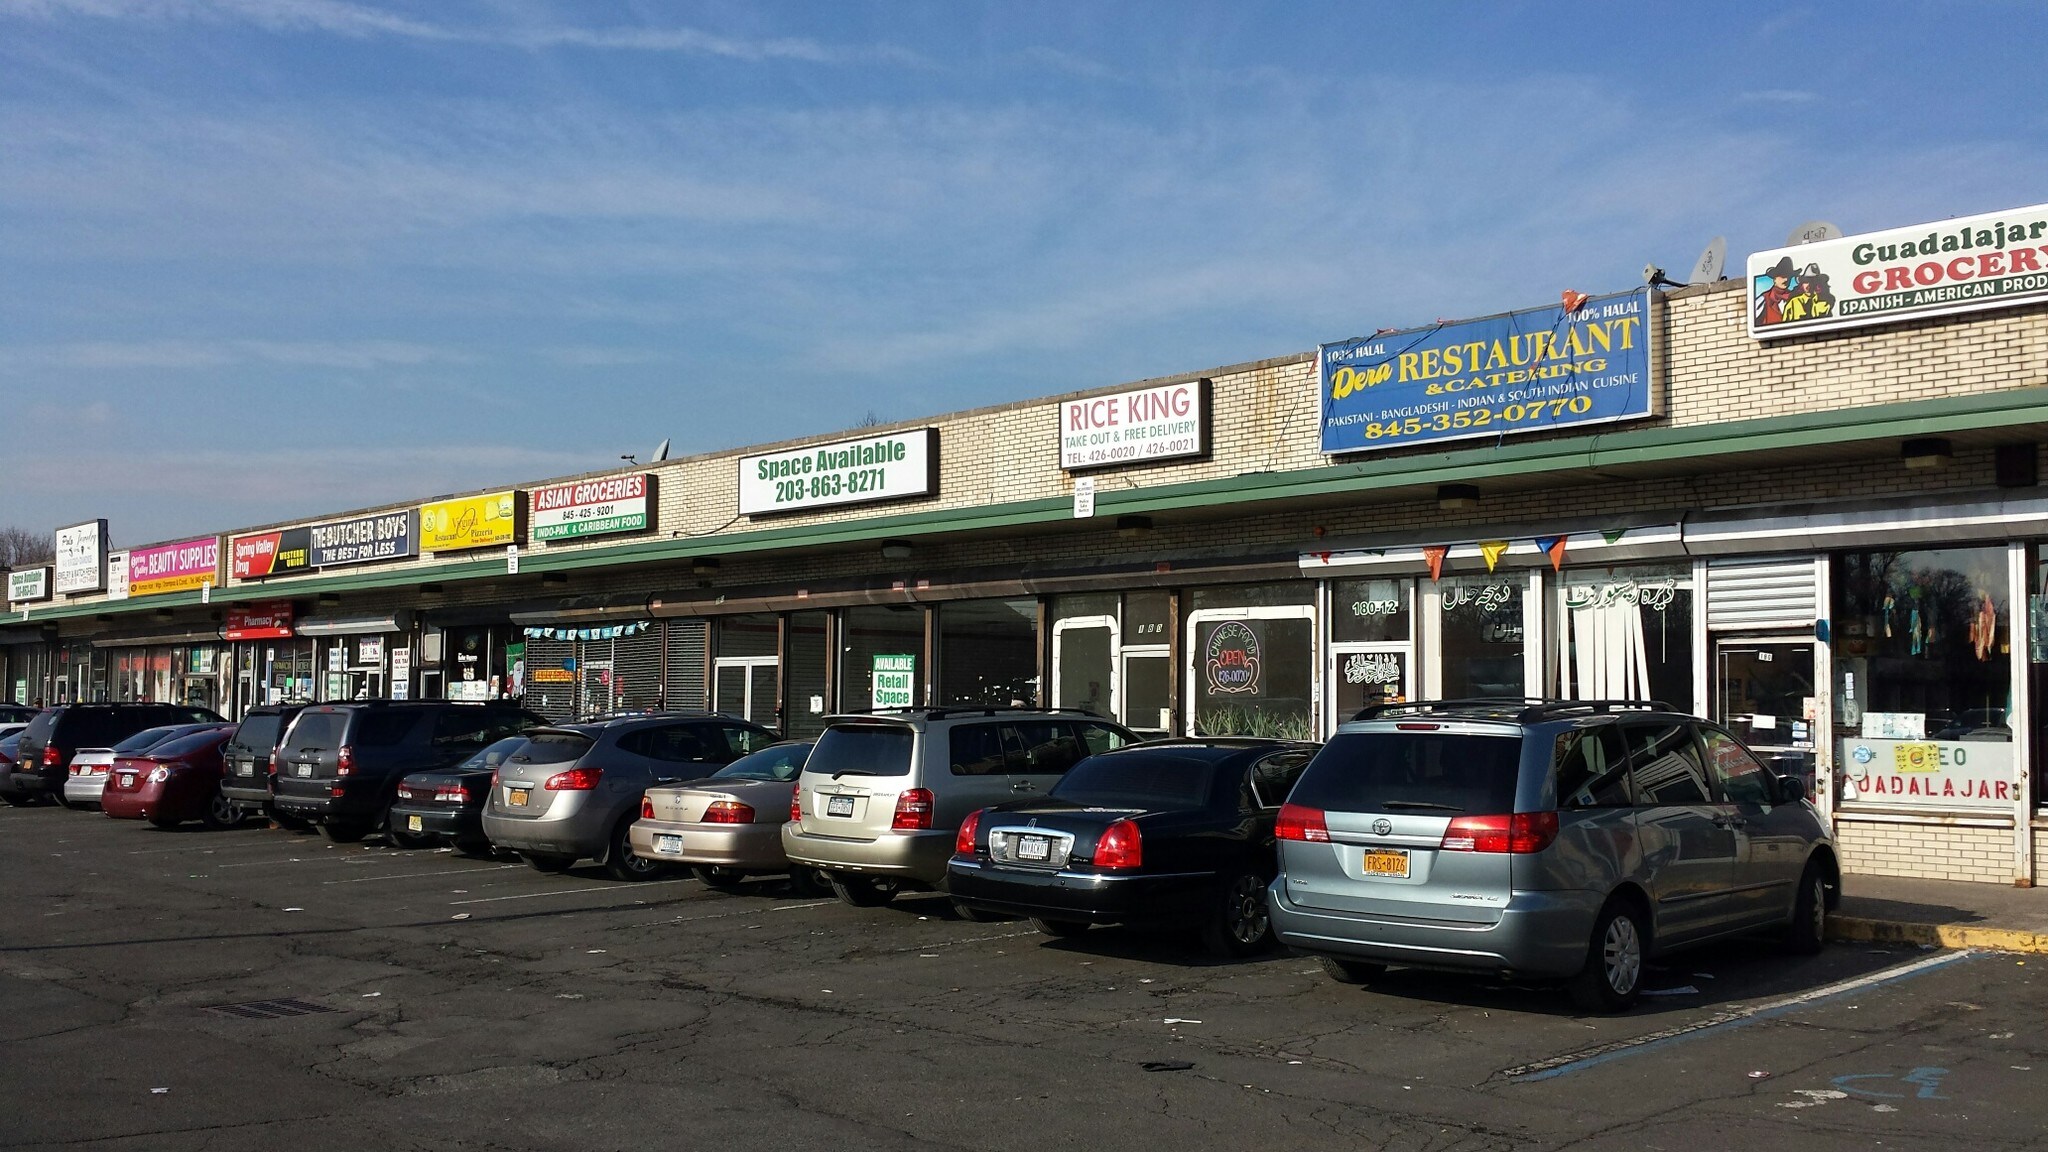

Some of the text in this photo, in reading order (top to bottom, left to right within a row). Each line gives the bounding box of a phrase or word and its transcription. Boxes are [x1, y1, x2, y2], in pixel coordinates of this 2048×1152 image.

[1842, 281, 1996, 314] SPANISH-AMERICAN
[1566, 301, 1642, 324] 100% HALAL
[1331, 316, 1640, 400] Dera RESTAURANT
[1356, 344, 1386, 358] HALAL
[1070, 387, 1190, 432] RICE KING
[1328, 413, 1373, 427] PAKISTANI
[1381, 401, 1449, 419] BANGLADESHI
[1457, 394, 1495, 408] INDIAN
[1497, 392, 1506, 403] &
[1507, 387, 1545, 402] SOUTH
[1548, 380, 1589, 396] INDIAN
[1592, 373, 1639, 389] CUISINE
[1364, 396, 1593, 440] 845-352-0770
[1065, 420, 1196, 449] TAKE OUT & FREE DELIVERY
[758, 440, 906, 481] Space Available
[1067, 438, 1195, 465] TEL: 426-0020 / 426-0021
[538, 476, 643, 510] ASIAN GROCERIES
[775, 468, 885, 503] 203-863-8271
[562, 510, 574, 521] 845
[579, 507, 592, 519] 425
[596, 504, 614, 517] 9201
[326, 520, 374, 548] BUTCHER
[377, 514, 407, 541] BOYS
[470, 528, 493, 539] Pizzeria
[536, 515, 643, 538] INDO-PAK & CARIBBEAN FOOD
[148, 549, 178, 575] BEAUTY
[180, 543, 217, 571] SUPPLIES
[235, 539, 275, 559] Spring Valley
[321, 541, 396, 563] THE BEST FOR LESS
[235, 559, 250, 575] Drug
[1352, 600, 1398, 616] 180-12
[244, 615, 273, 628] Pharmacy
[1210, 625, 1255, 658] CHINESE FOOD
[874, 657, 913, 671] AVAILABLE
[1219, 650, 1246, 666] OPEN
[877, 674, 909, 689] Retail
[876, 689, 909, 706] Space
